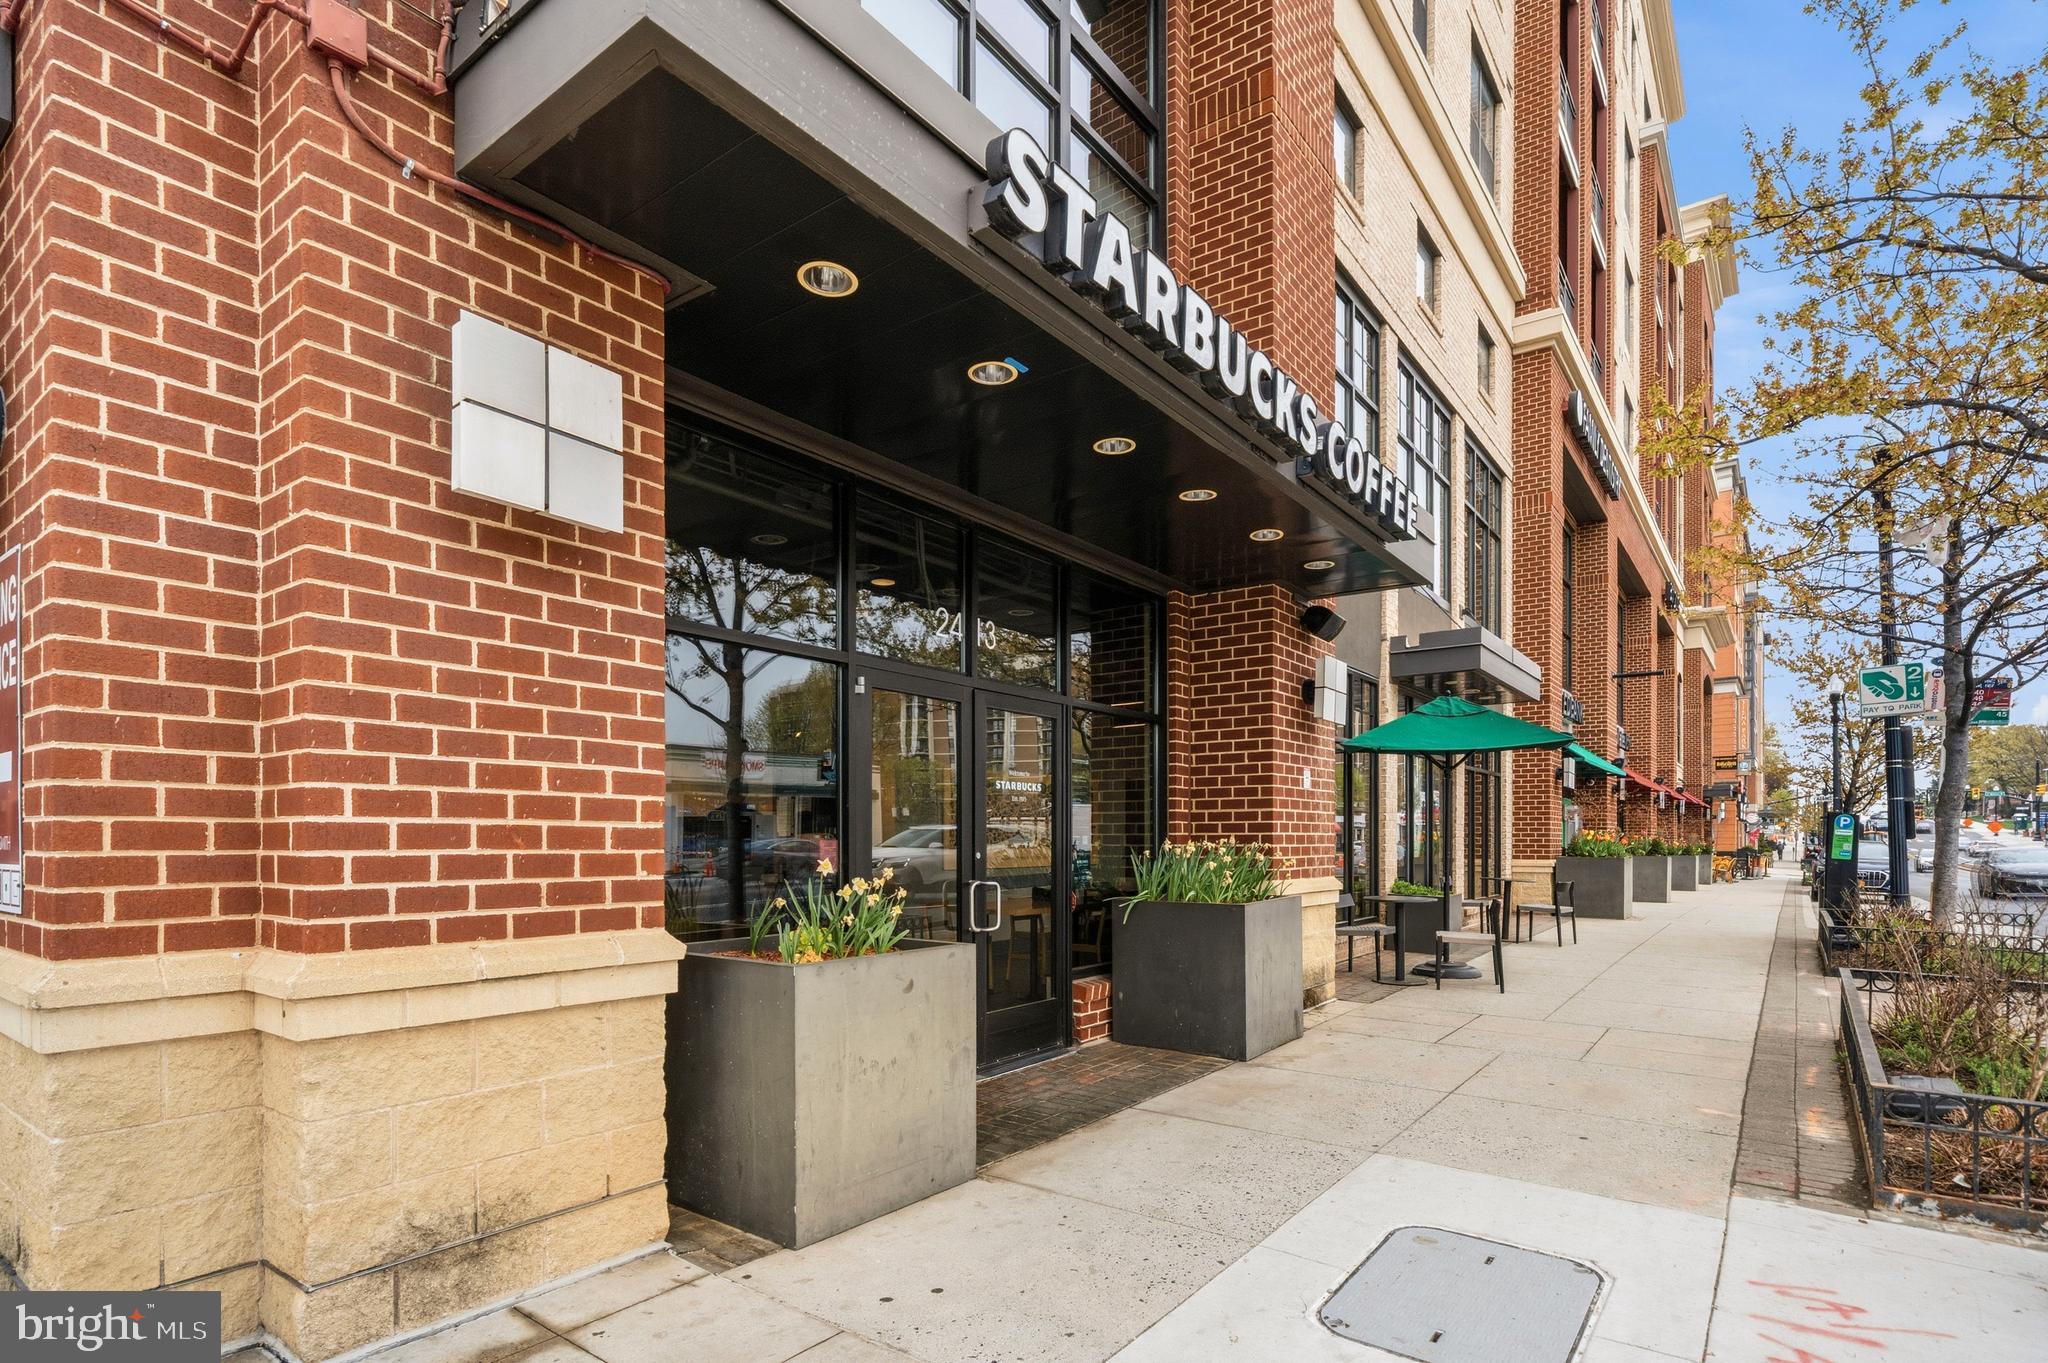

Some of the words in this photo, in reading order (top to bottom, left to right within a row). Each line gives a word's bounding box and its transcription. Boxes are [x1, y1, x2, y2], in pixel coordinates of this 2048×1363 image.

[1000, 127, 1318, 456] STARBUCKS
[1327, 421, 1418, 539] COFFEE
[1907, 666, 1922, 680] 2
[1863, 706, 1879, 715] PAY
[1899, 703, 1922, 711] PARK
[995, 780, 1043, 792] STARBUCKS
[1840, 816, 1851, 828] P
